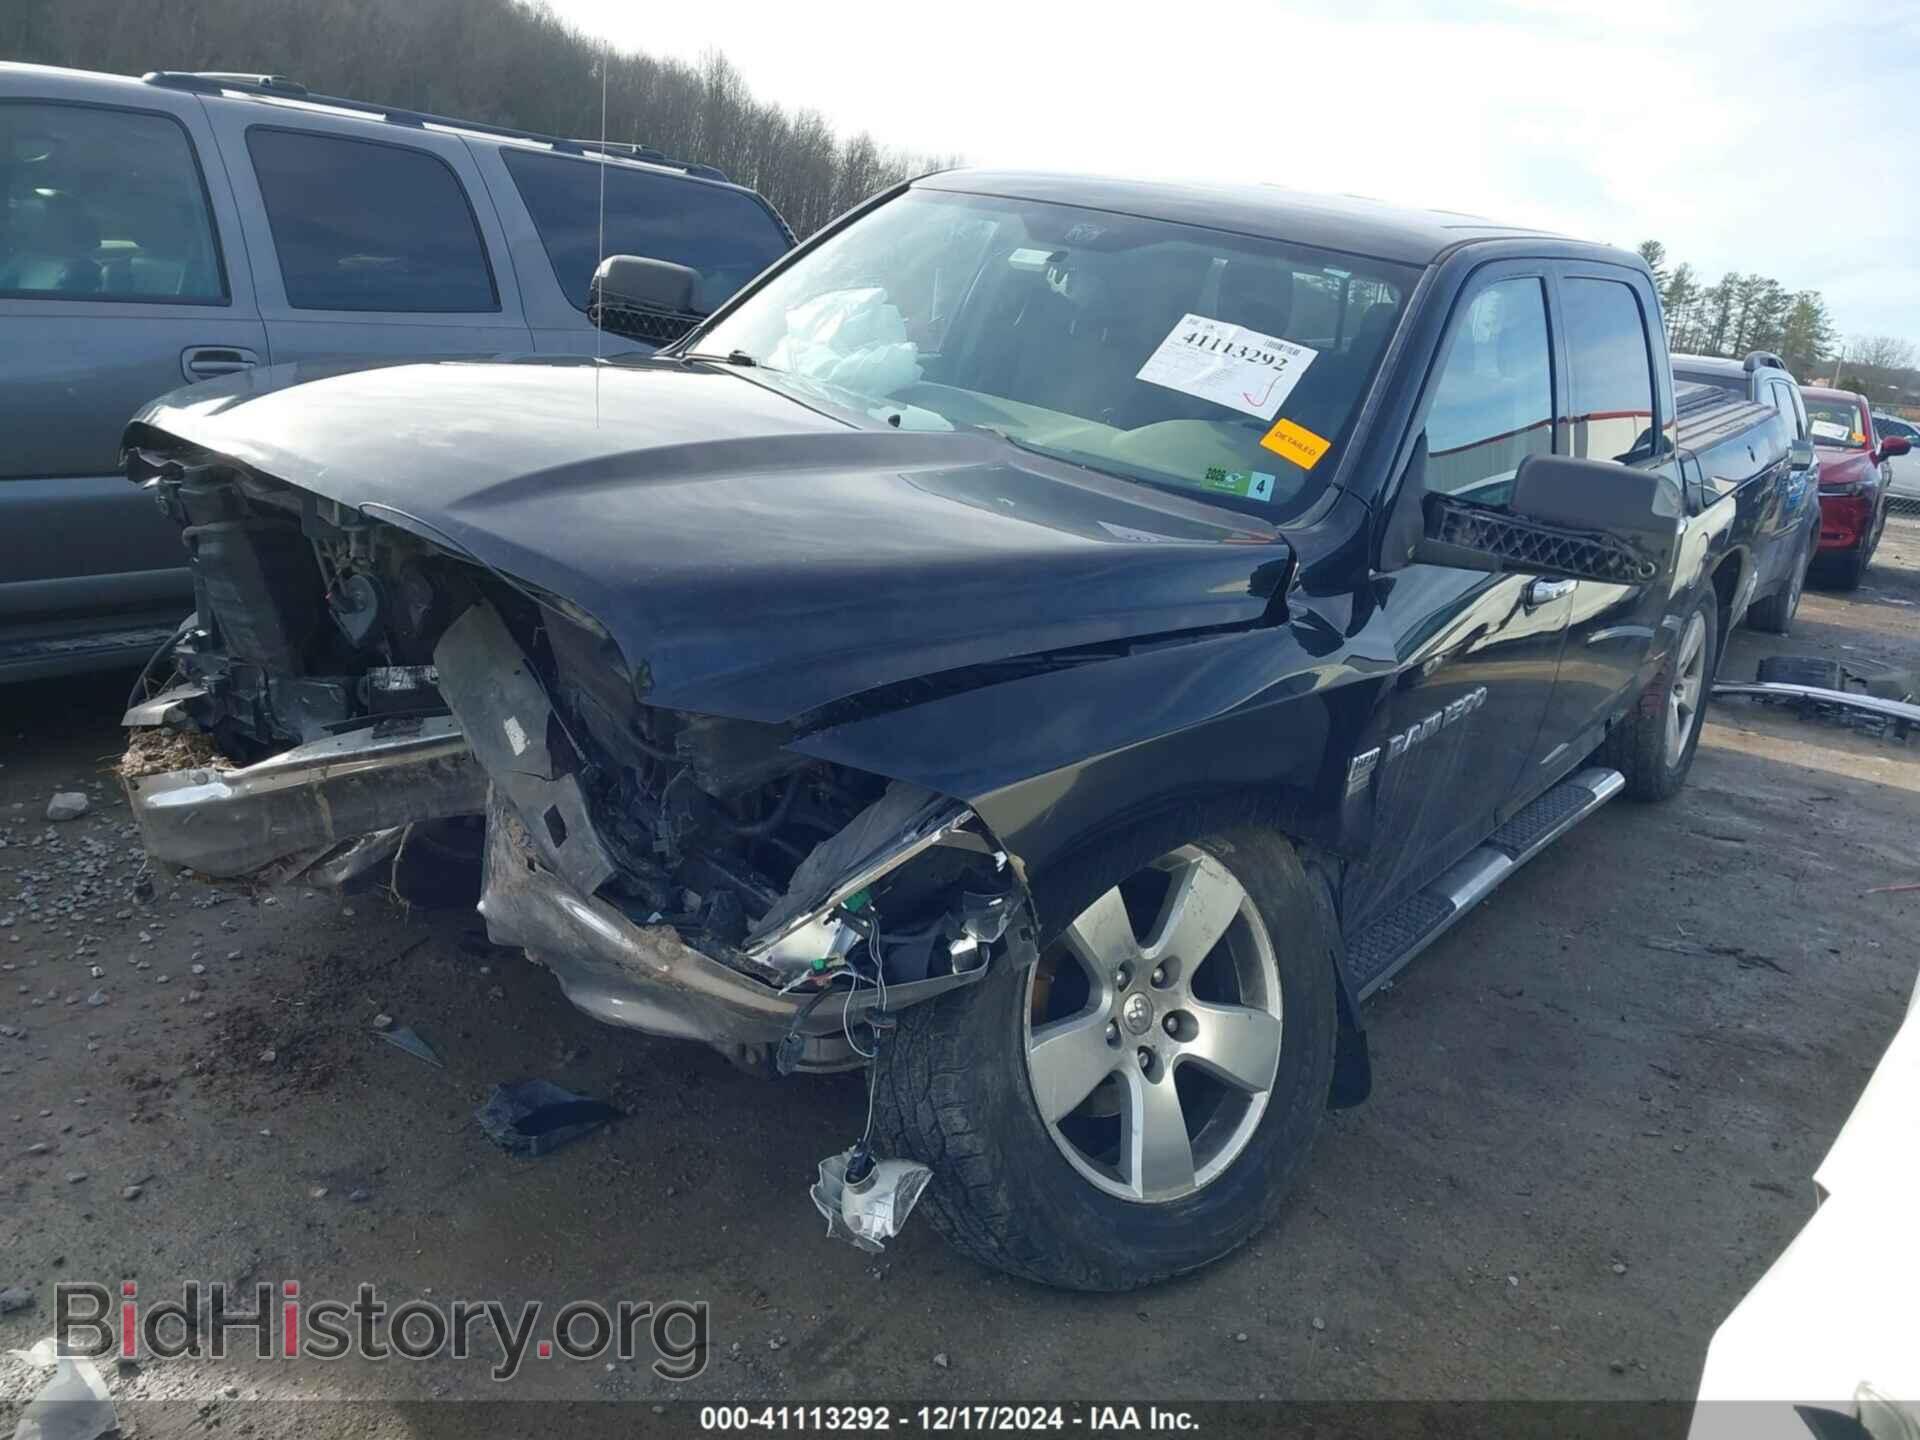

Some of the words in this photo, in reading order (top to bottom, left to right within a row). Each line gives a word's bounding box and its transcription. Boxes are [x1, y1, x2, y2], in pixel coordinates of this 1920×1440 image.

[1183, 332, 1289, 372] 41113292
[1274, 431, 1317, 457] DETAILED
[1256, 480, 1266, 494] 4
